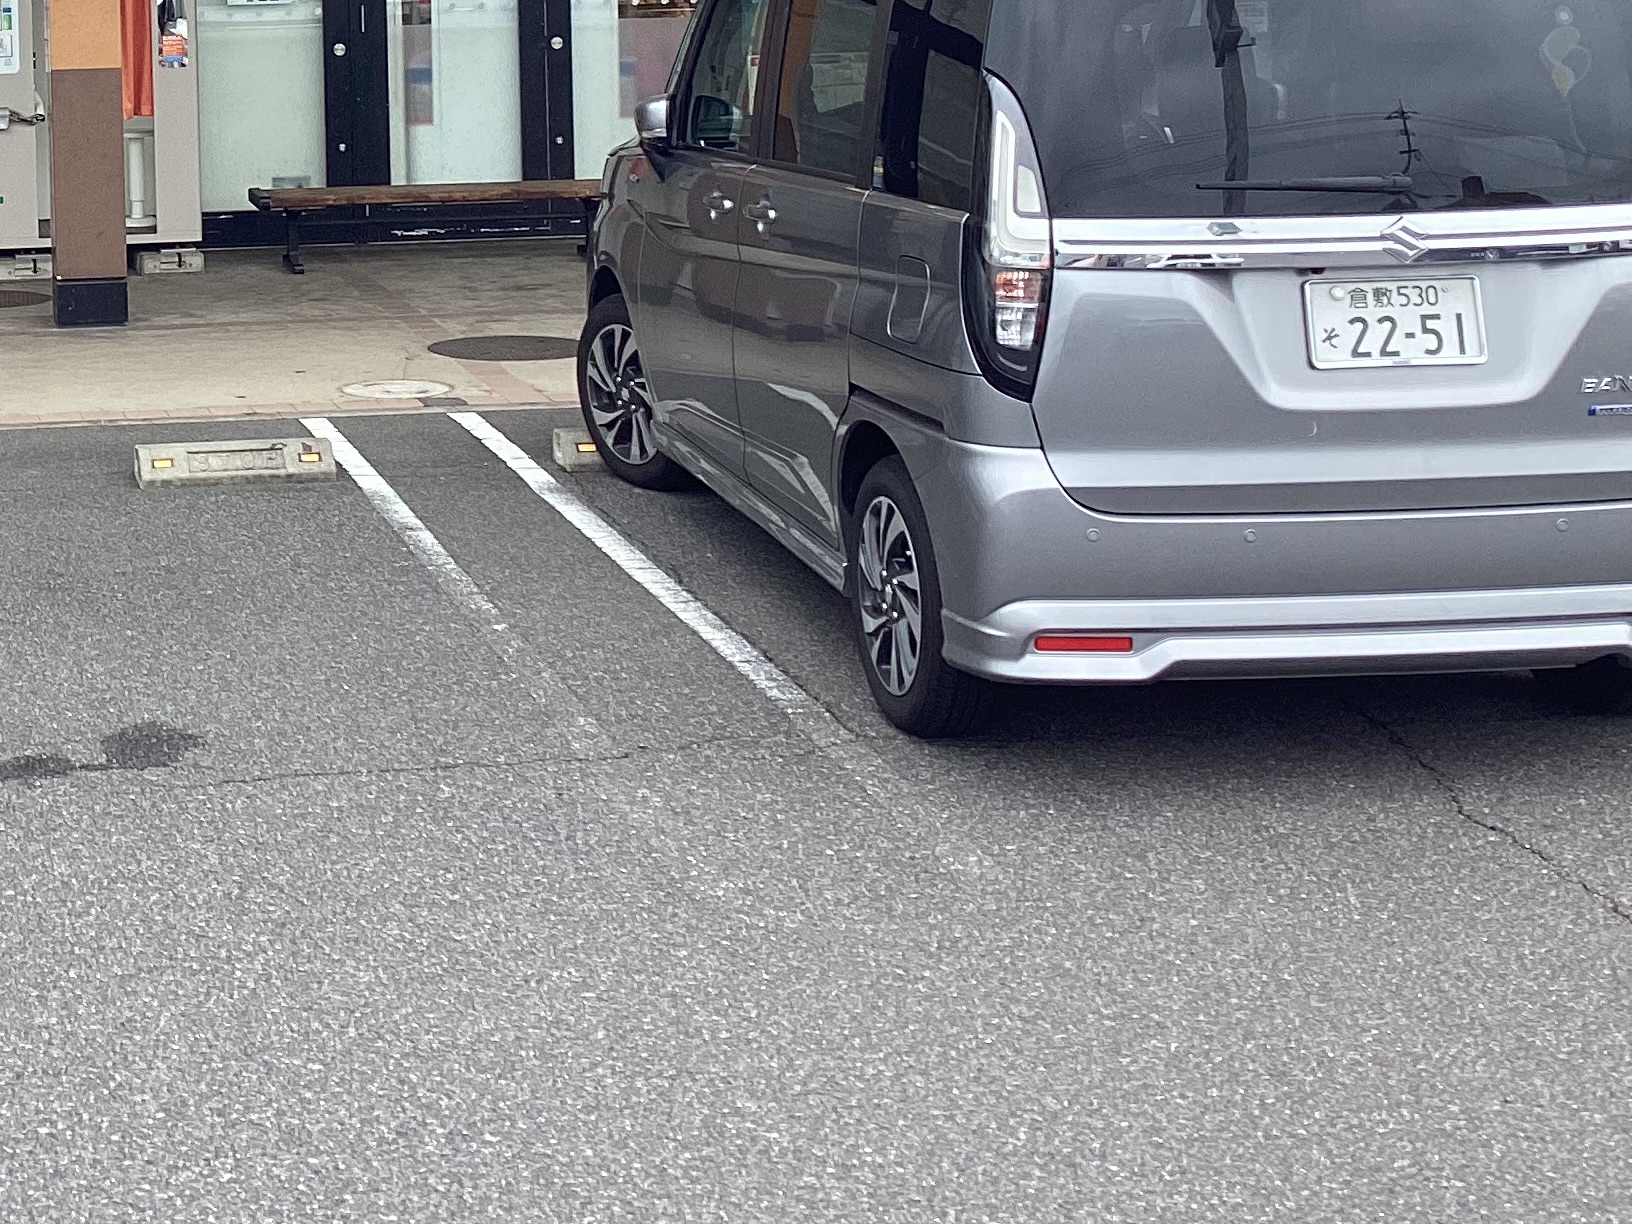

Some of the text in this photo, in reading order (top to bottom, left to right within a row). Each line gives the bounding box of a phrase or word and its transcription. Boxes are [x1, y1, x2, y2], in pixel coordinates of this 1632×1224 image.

[1347, 285, 1439, 309] 倉敷530
[1322, 313, 1467, 359] そ 22-51
